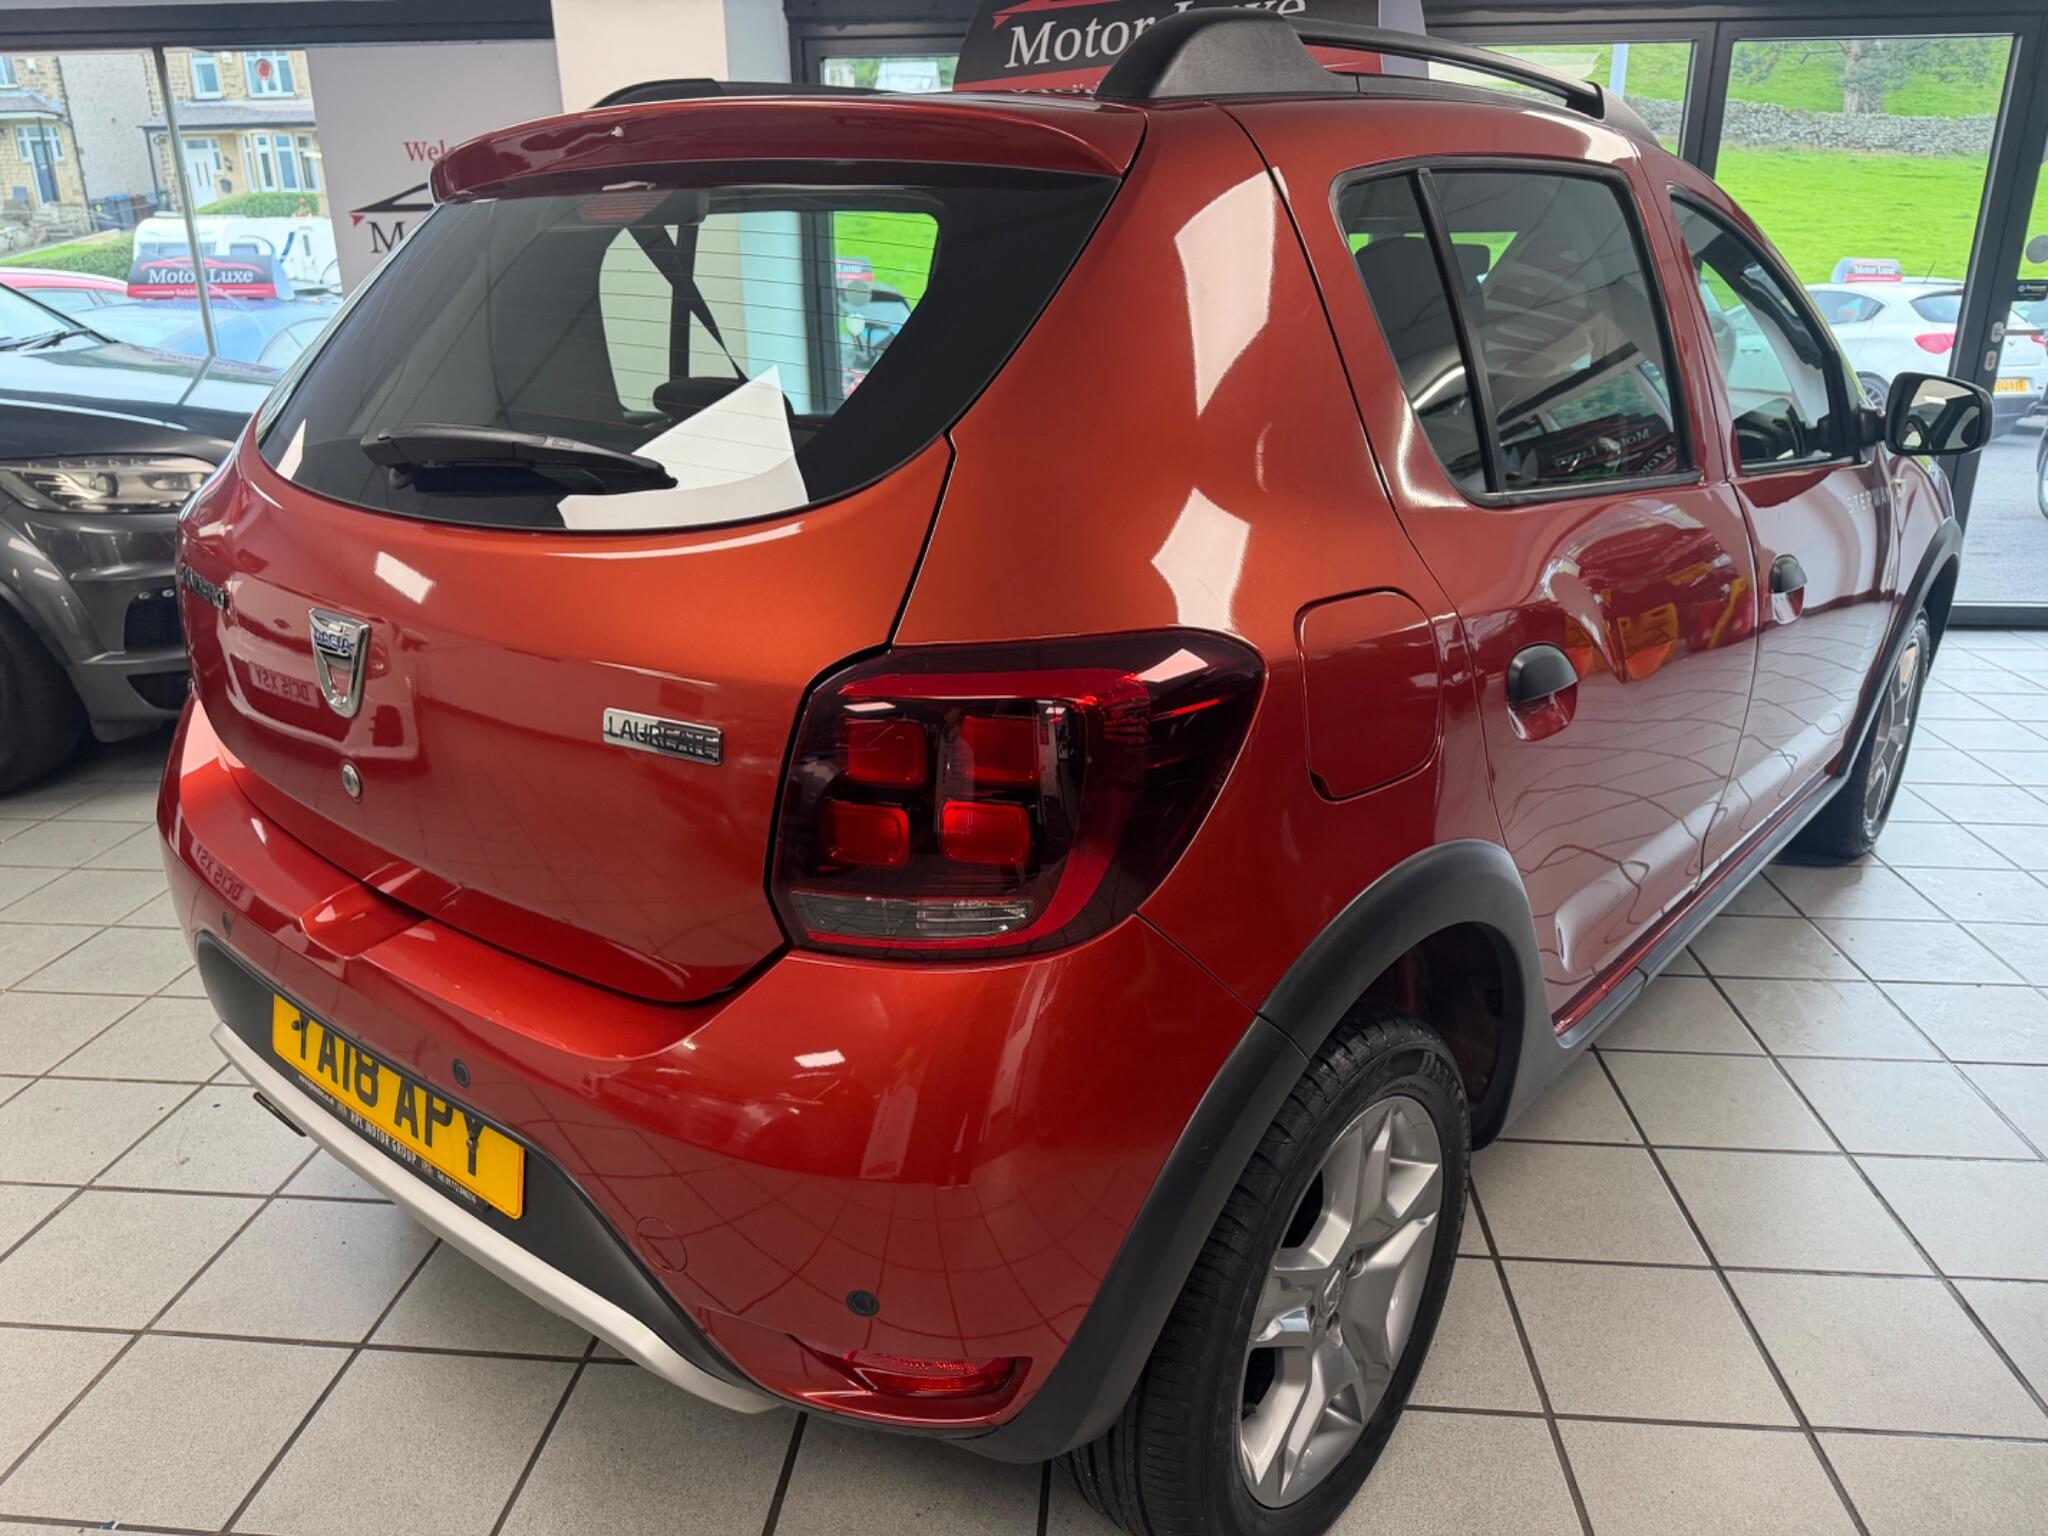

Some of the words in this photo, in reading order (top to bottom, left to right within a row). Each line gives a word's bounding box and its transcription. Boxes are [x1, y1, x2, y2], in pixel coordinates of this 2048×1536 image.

[148, 268, 196, 284] Moto
[209, 268, 254, 283] Luxe
[608, 715, 720, 763] LAUREATE
[297, 1013, 379, 1108] YA18
[394, 1078, 485, 1177] APY
